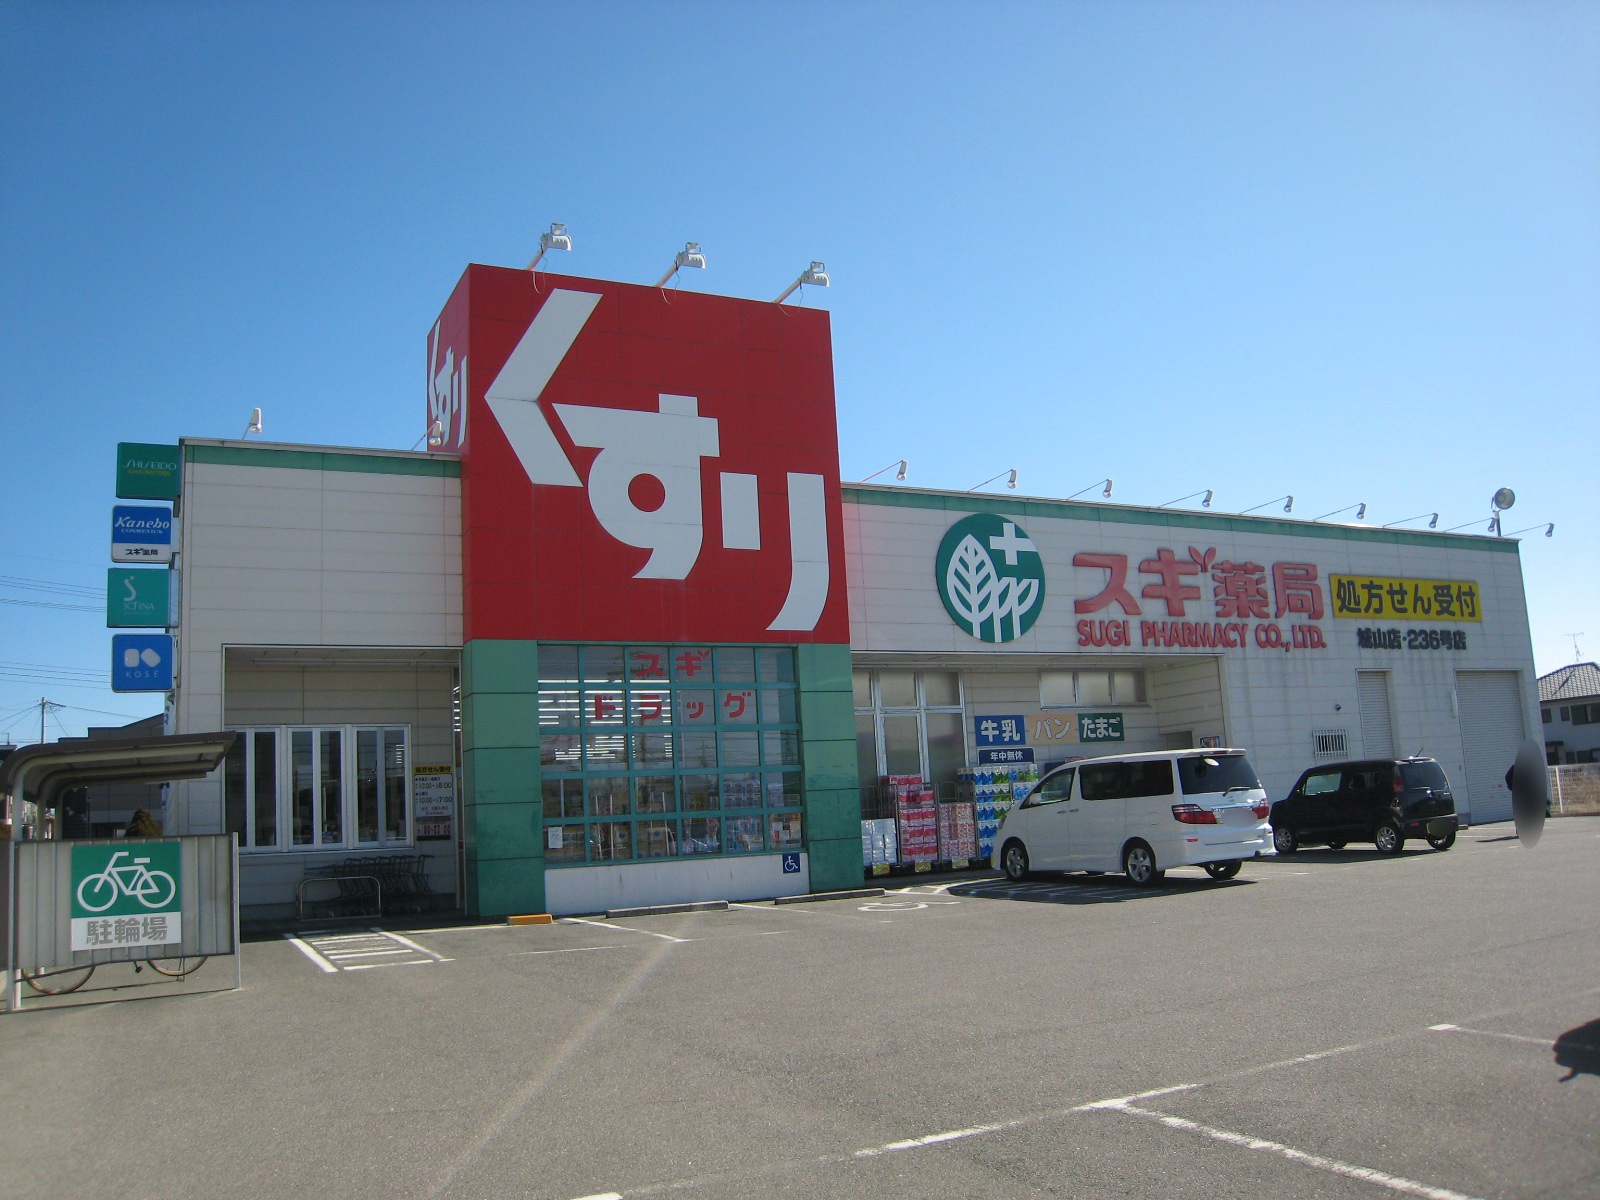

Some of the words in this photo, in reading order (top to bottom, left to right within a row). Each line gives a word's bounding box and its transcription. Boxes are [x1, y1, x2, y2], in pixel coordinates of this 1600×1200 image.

[122, 459, 177, 471] SHISEIDO
[484, 288, 830, 631] くすり
[115, 516, 170, 529] Kanebo
[1073, 546, 1325, 620] スギ薬局
[1336, 578, 1476, 618] 処方せん受付
[1077, 620, 1131, 647] SUGI
[1141, 621, 1248, 648] PHARMACY
[636, 649, 710, 677] スギ
[594, 691, 752, 721] ドラッグ
[980, 719, 1020, 743] 牛乳
[1034, 718, 1070, 740] パン
[1081, 717, 1121, 739] たまご
[990, 751, 1024, 762] 年中無休
[87, 916, 168, 946] 駐輪場
